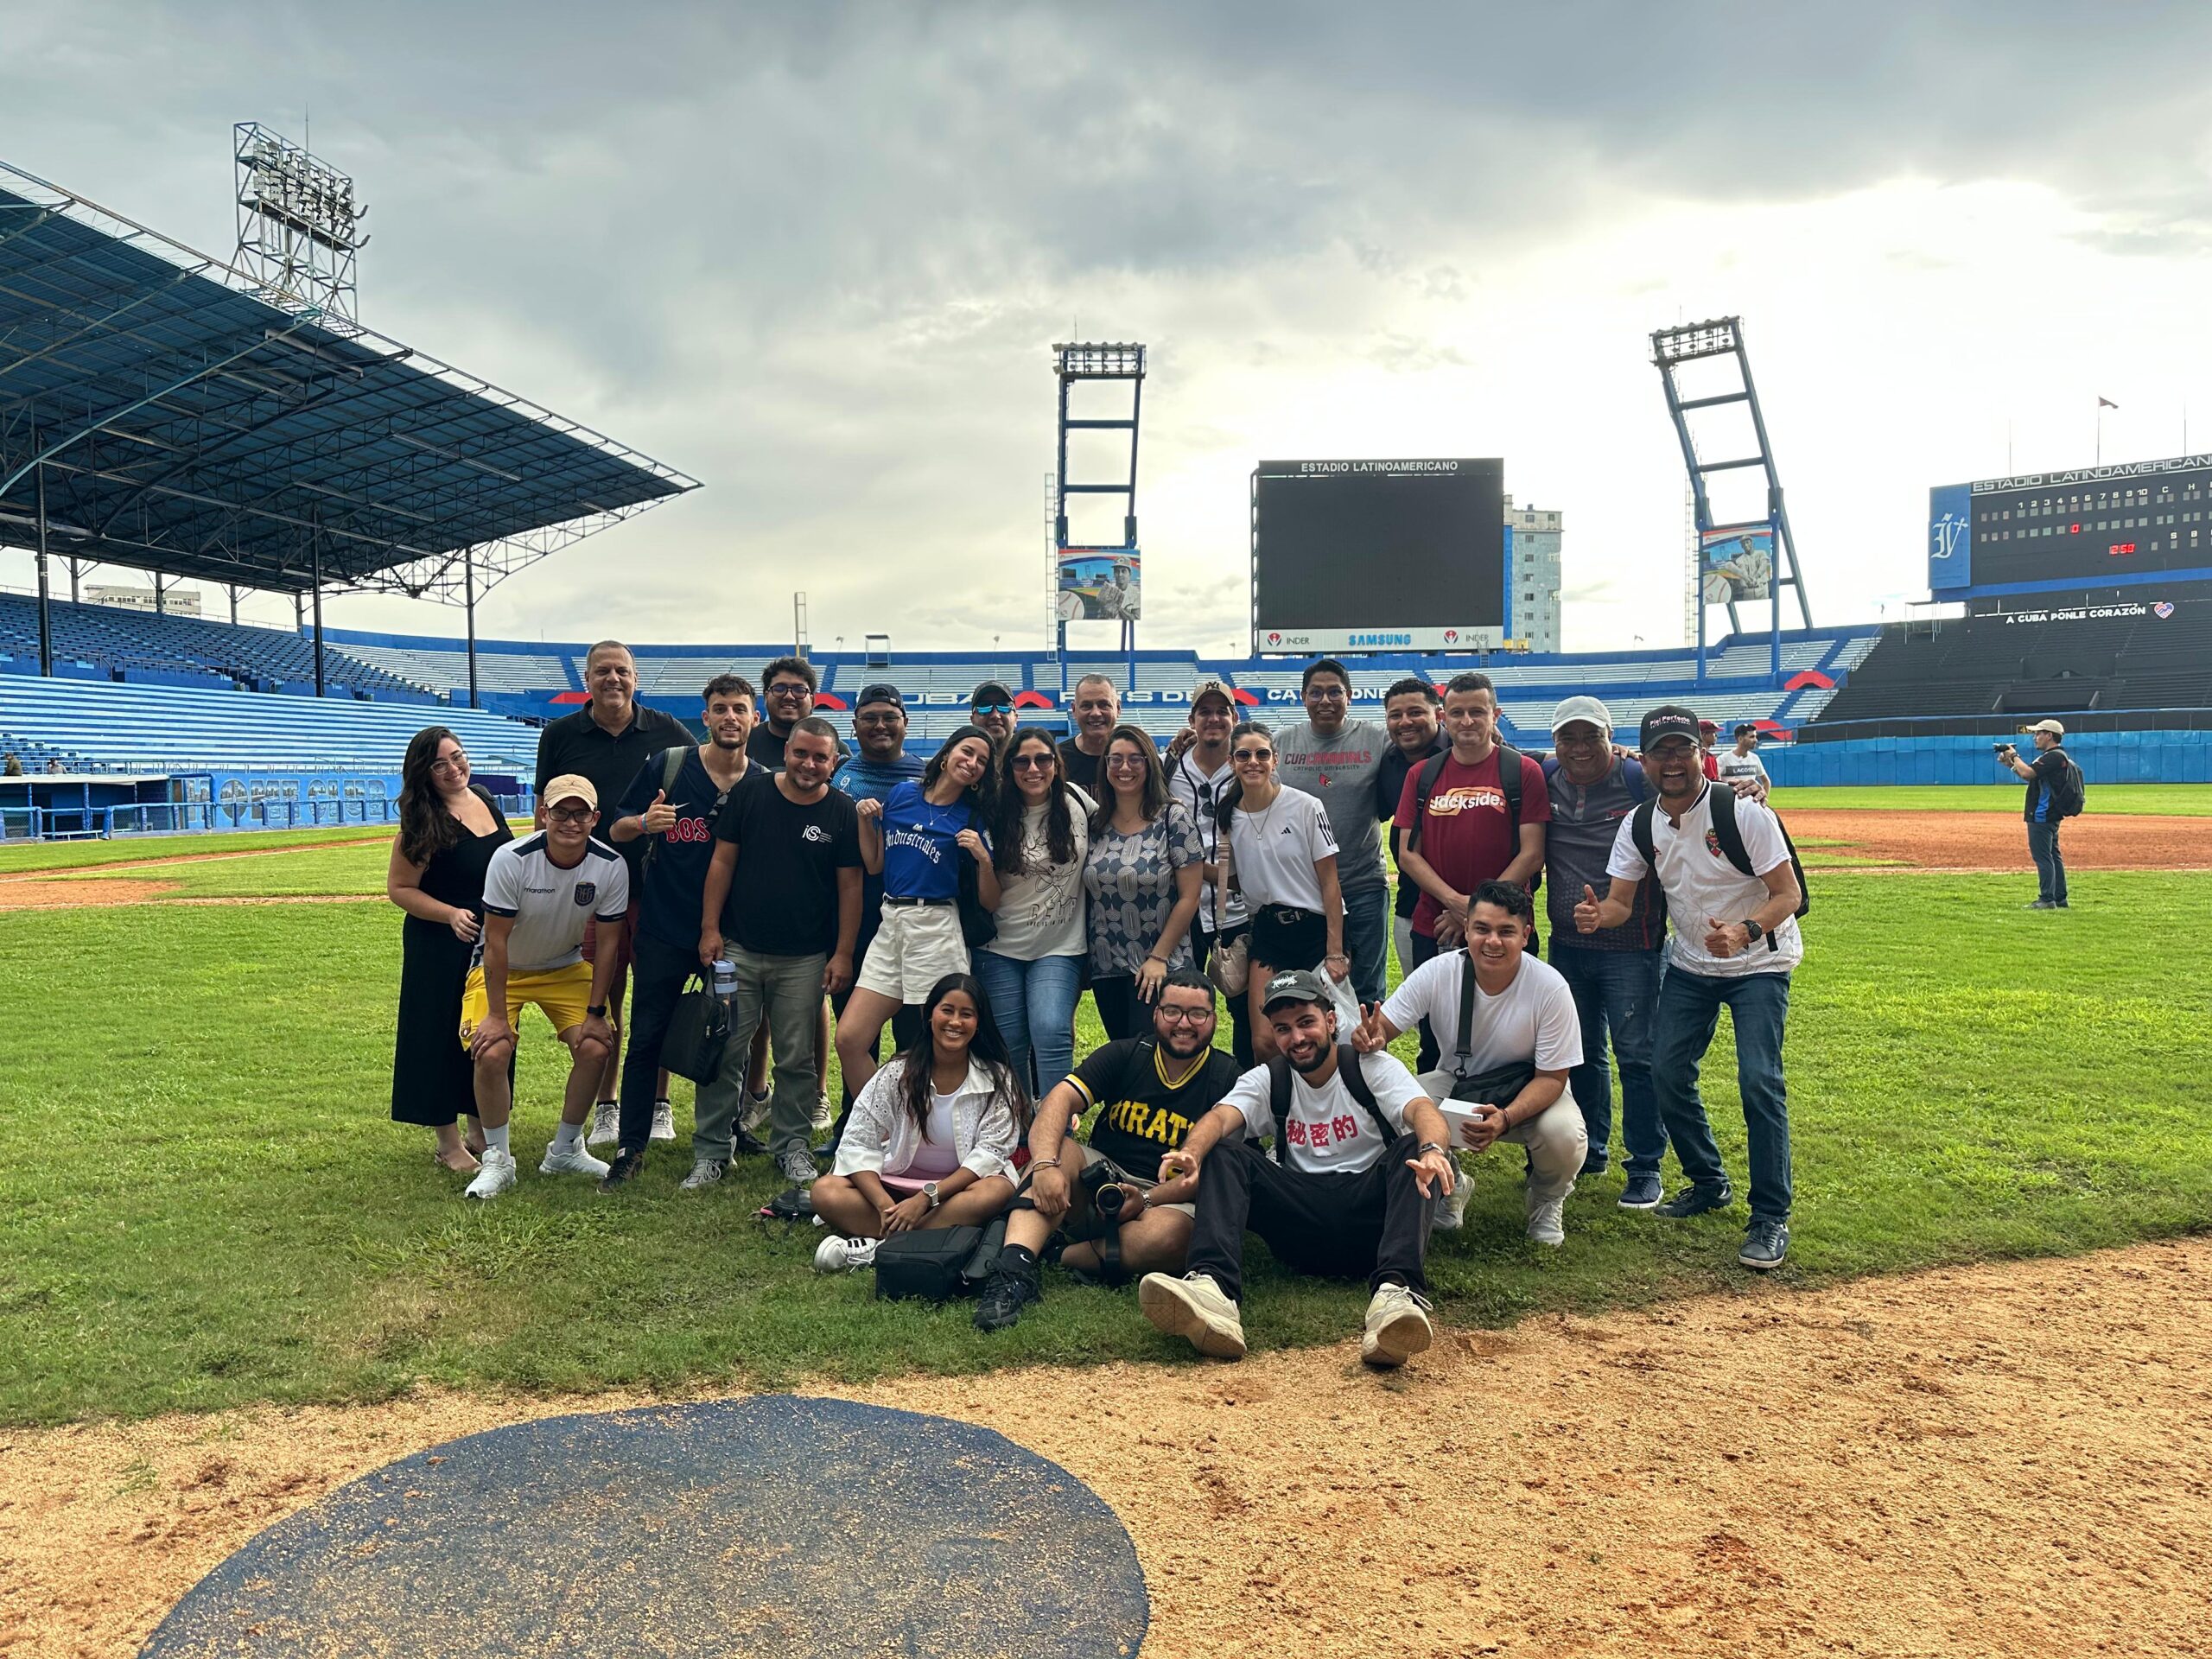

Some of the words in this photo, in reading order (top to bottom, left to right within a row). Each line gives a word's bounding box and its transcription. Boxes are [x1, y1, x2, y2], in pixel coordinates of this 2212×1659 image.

[1301, 462, 1349, 472] ESTADIO
[1353, 461, 1458, 472] LATINOAMERICANO
[1973, 474, 2043, 492] ESTADIO
[2050, 454, 2212, 484] LATINOAMERICAN
[2018, 612, 2047, 623] CUBA
[2050, 609, 2086, 621] PONLE
[2089, 605, 2145, 618] CORAZÓN
[1348, 633, 1411, 646] SAMSUNG
[1465, 634, 1489, 643] INDER
[1324, 763, 1360, 772] UNIVERSITY
[185, 778, 301, 823] HOME
[308, 778, 386, 820] CLUB
[885, 828, 942, 864] Industriales
[1287, 1115, 1358, 1147] 秘密的
